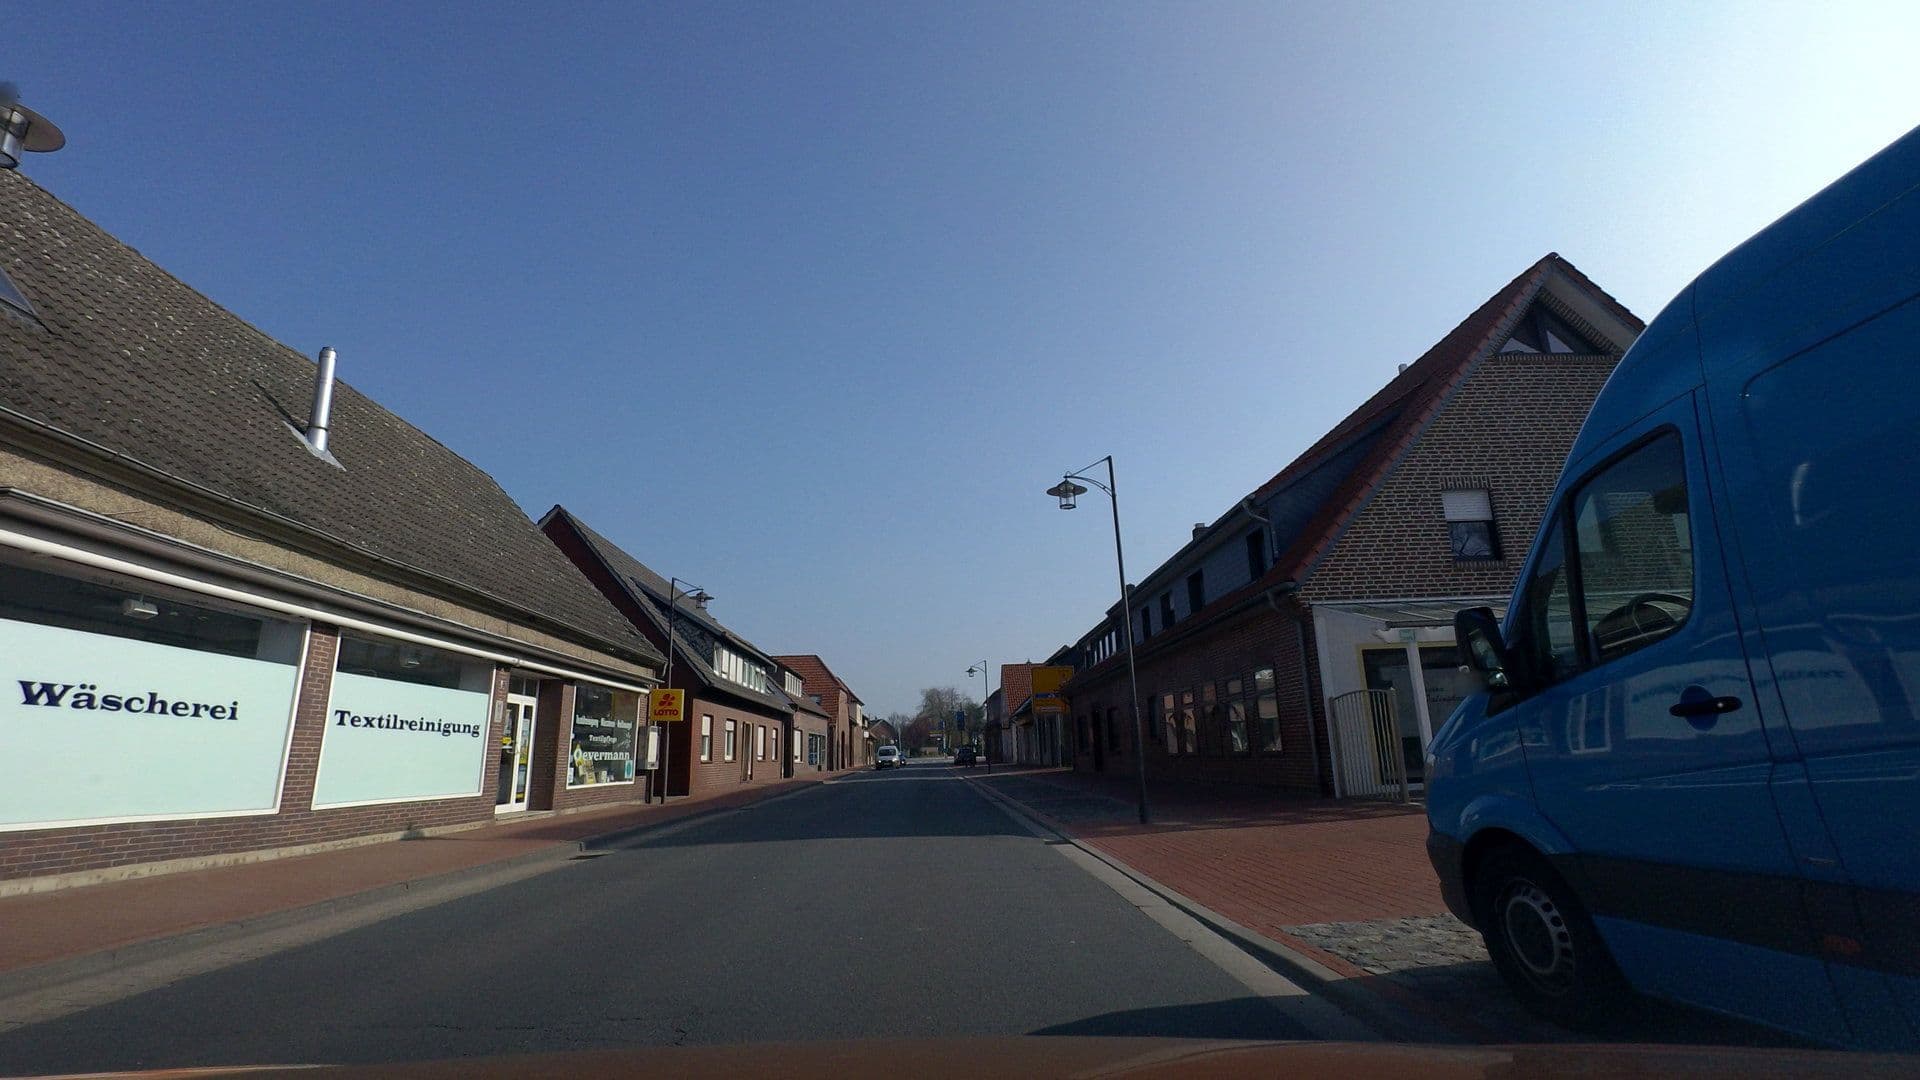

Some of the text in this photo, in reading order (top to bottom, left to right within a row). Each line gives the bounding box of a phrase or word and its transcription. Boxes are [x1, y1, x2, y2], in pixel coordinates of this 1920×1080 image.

[18, 680, 239, 721] Wäscherei
[334, 709, 480, 738] Textilreinigung
[573, 748, 630, 761] Oevermann
